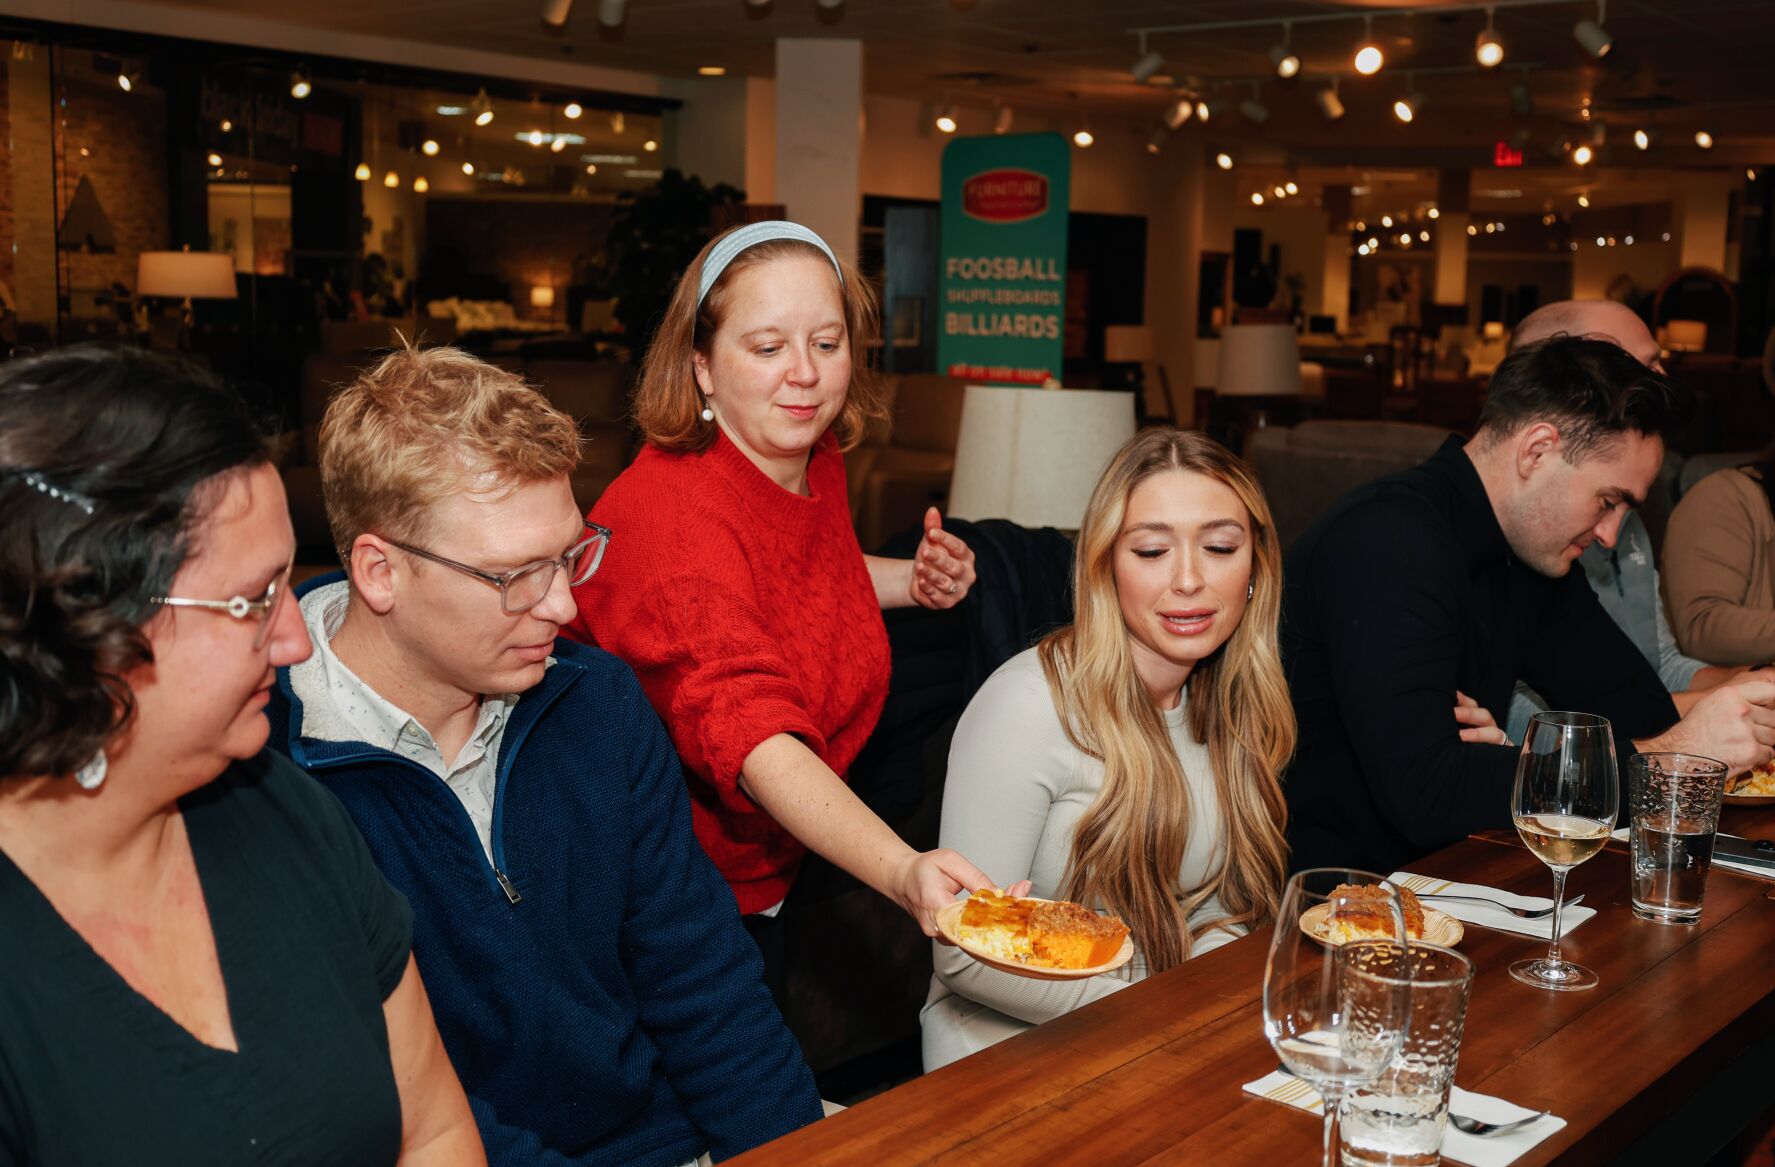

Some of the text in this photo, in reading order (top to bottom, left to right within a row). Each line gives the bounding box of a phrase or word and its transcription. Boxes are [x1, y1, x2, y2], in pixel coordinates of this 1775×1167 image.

[945, 257, 1061, 281] FOOSBALL
[947, 288, 1060, 306] SHUFFLEBOARDS
[945, 312, 1059, 340] BILLIARDS
